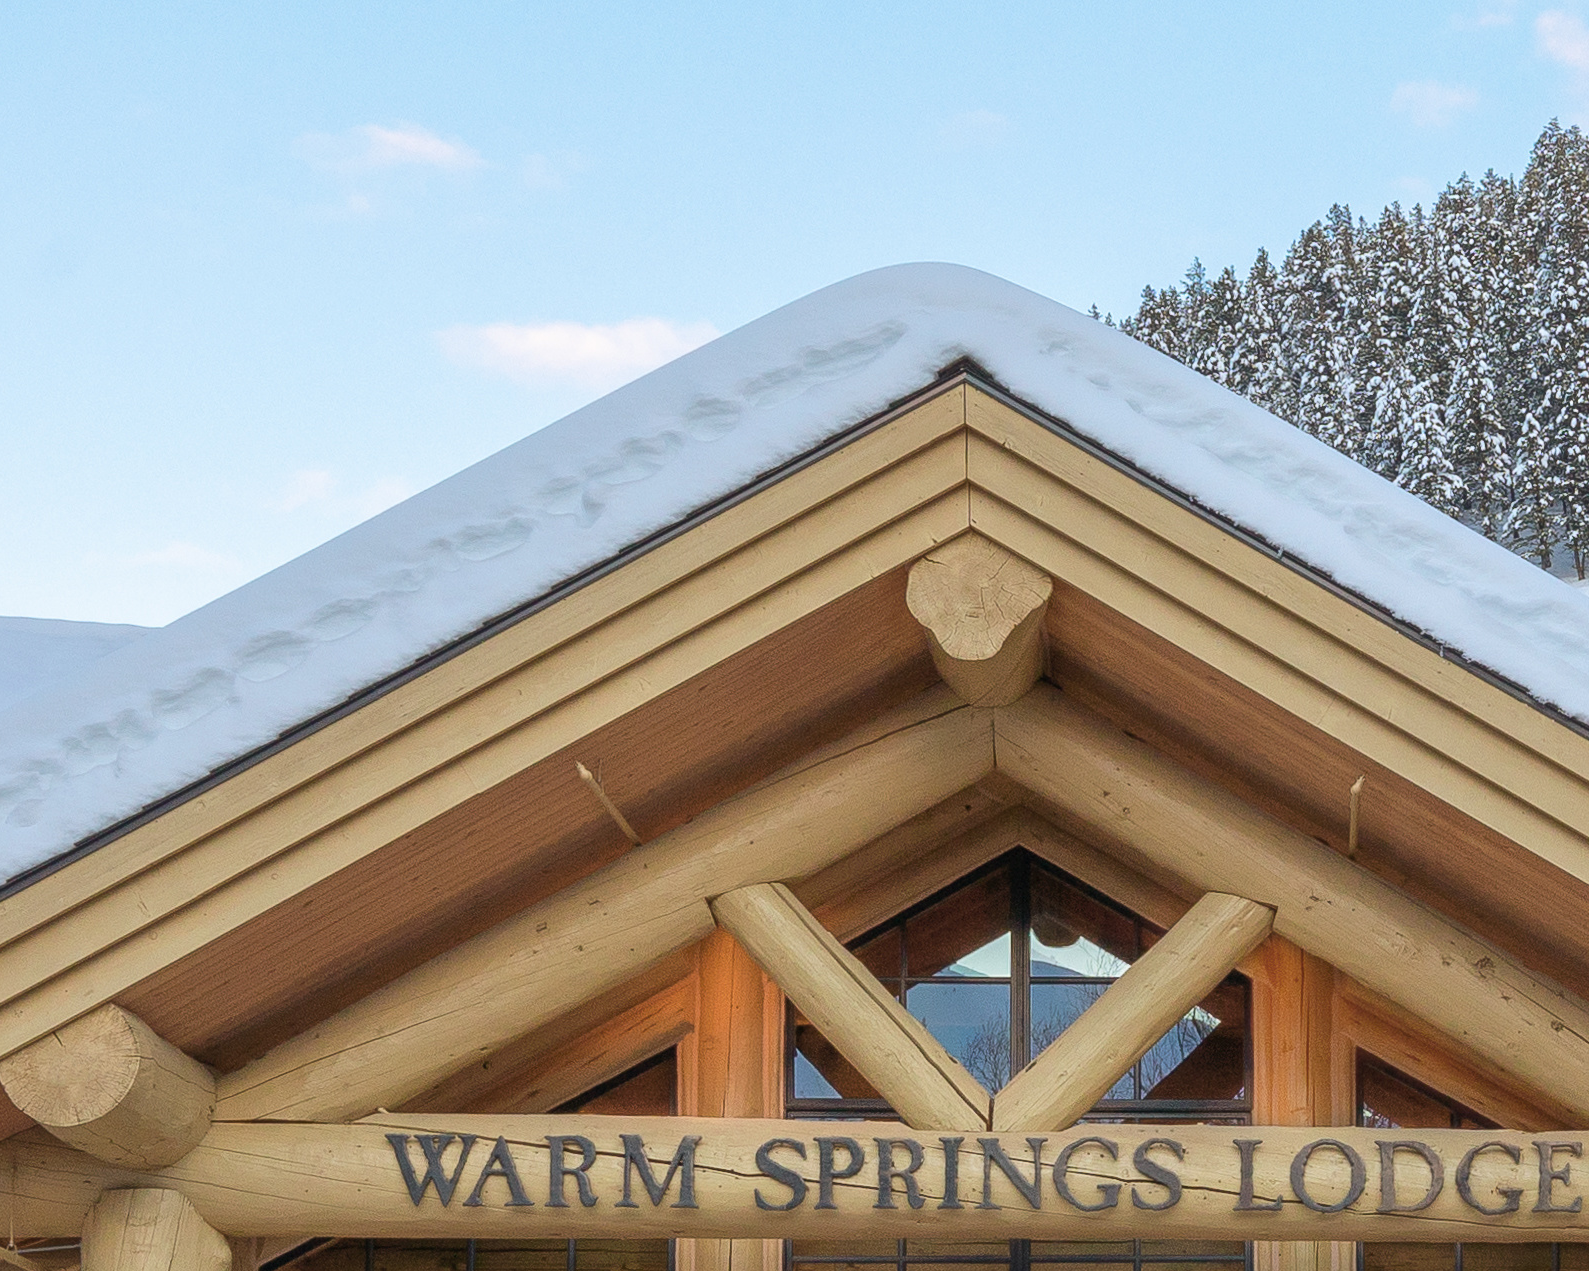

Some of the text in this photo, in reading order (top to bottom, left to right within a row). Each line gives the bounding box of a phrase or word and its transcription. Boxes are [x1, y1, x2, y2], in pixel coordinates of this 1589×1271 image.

[384, 1133, 1584, 1215] WARM SPRINGS LODGE
